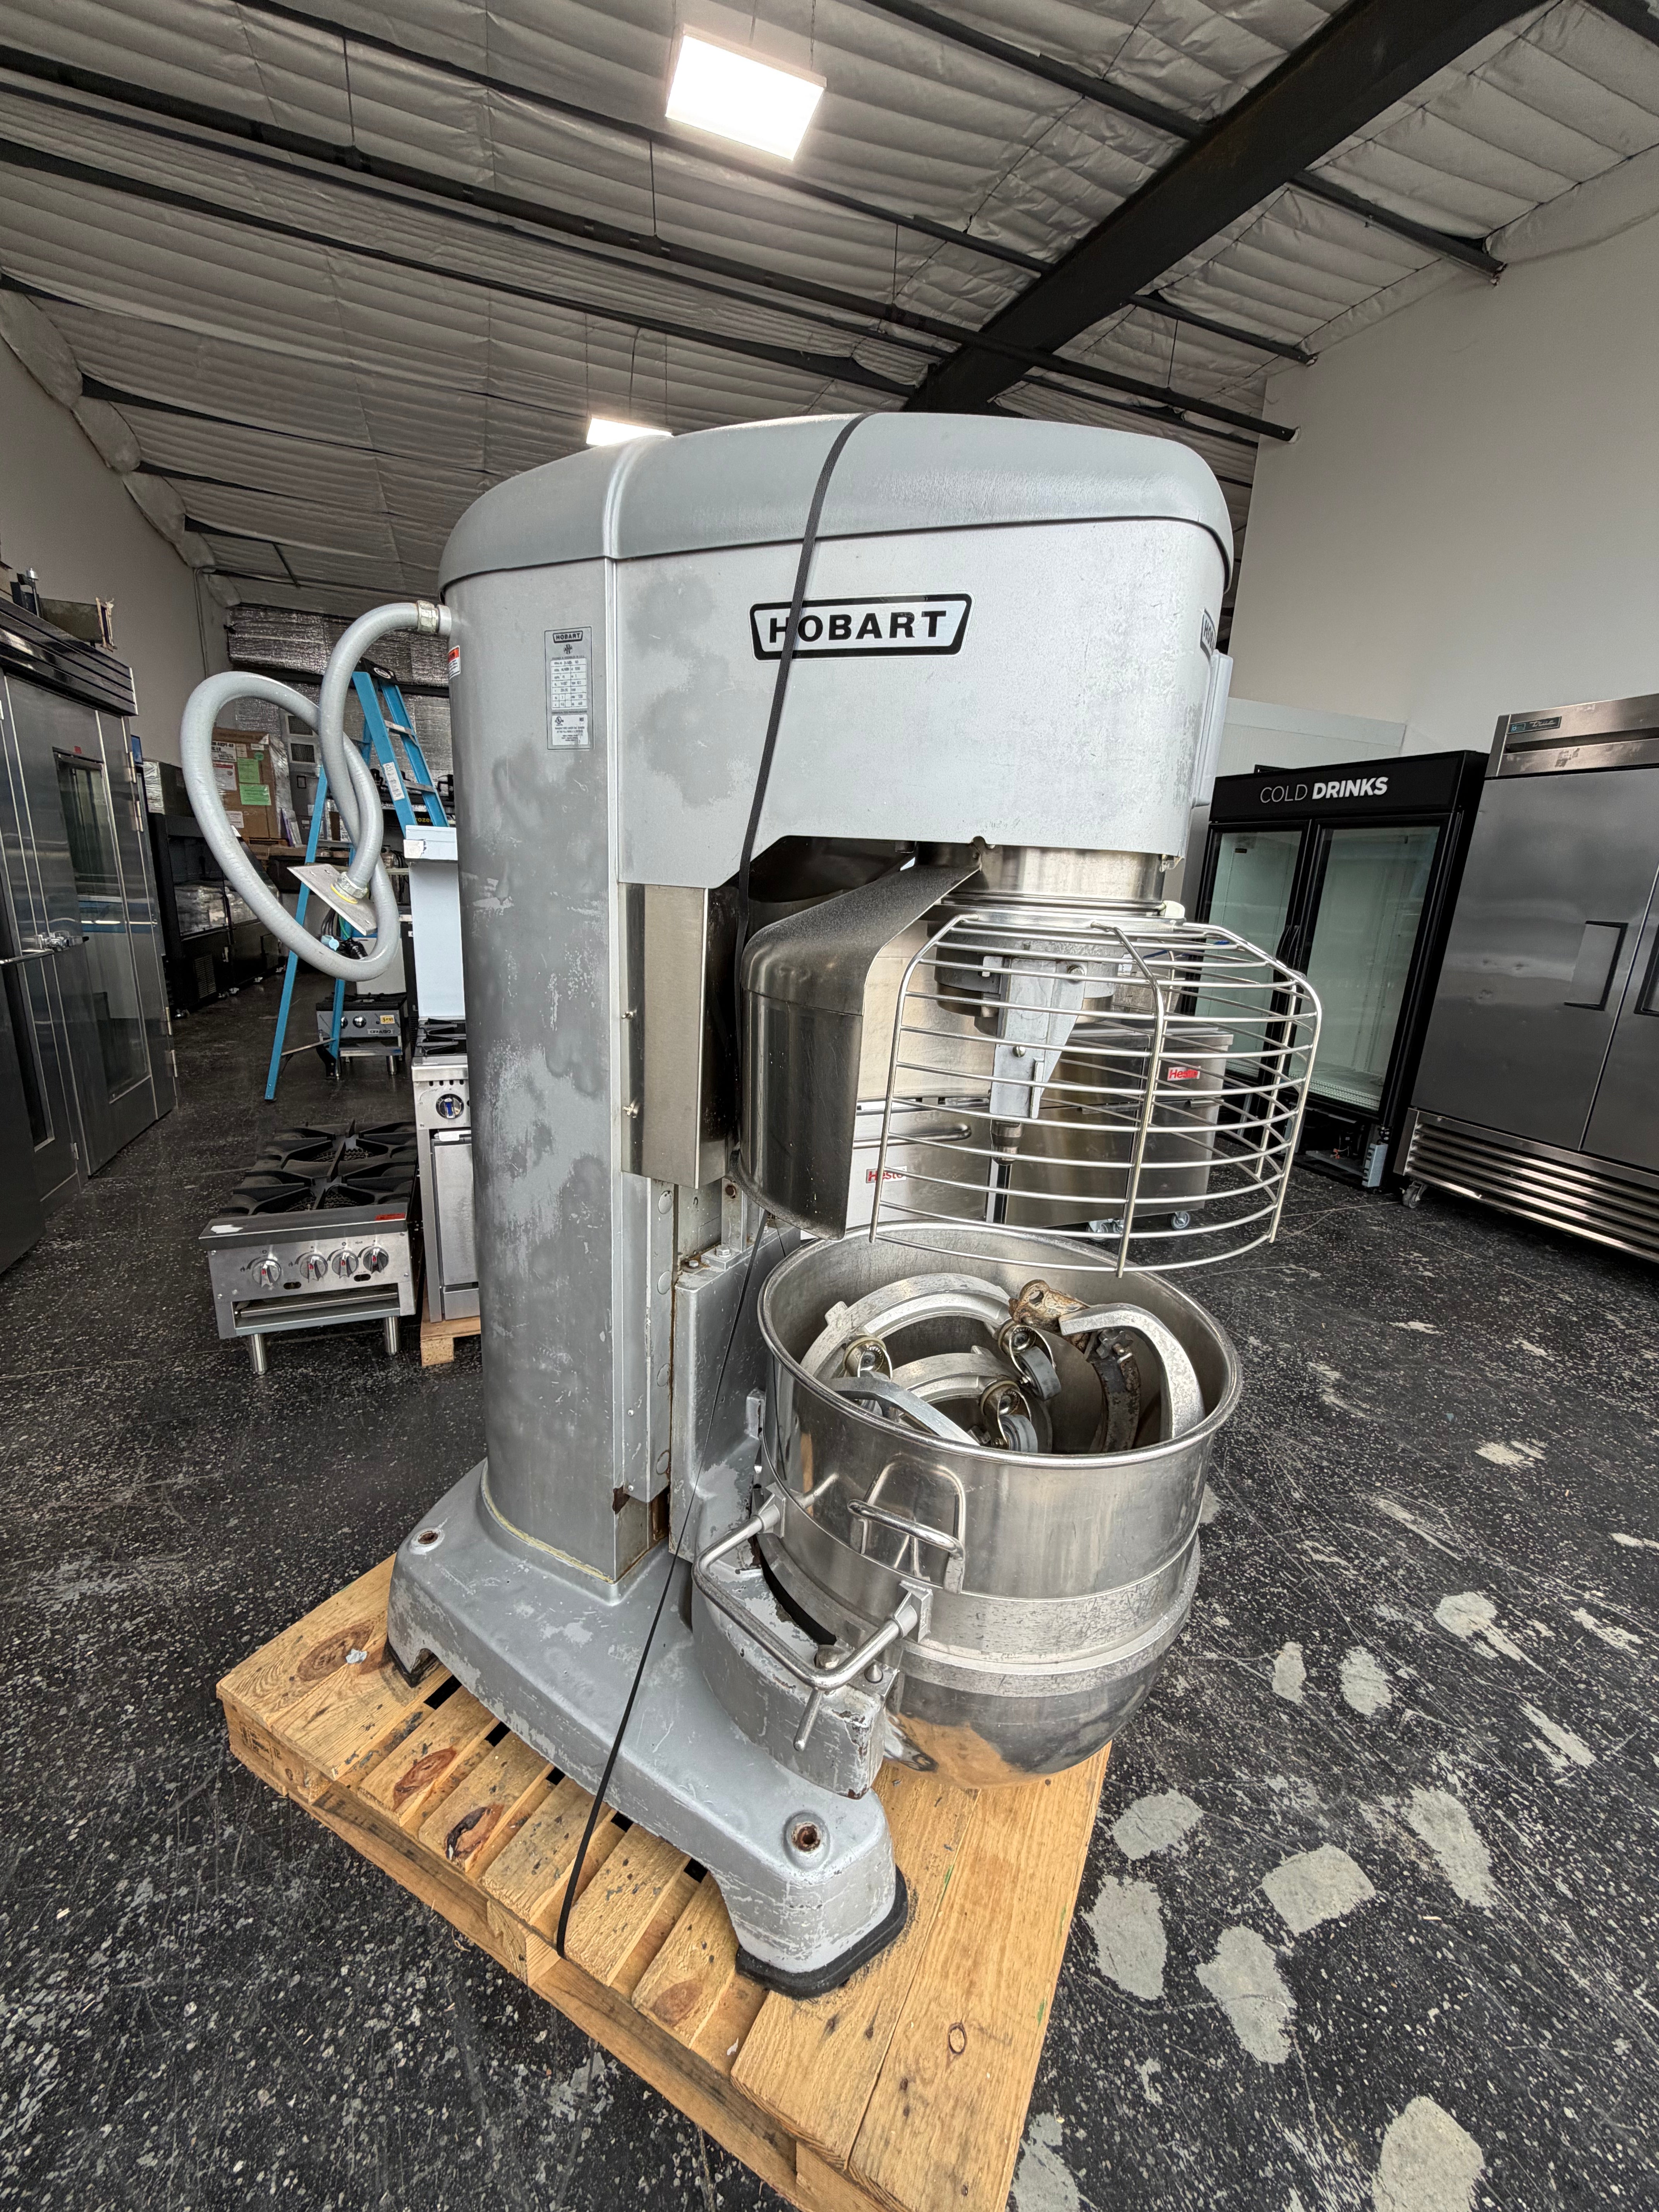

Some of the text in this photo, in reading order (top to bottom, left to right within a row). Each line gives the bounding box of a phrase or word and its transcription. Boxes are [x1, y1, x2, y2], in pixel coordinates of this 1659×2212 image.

[769, 610, 946, 643] HOBART
[1260, 776, 1389, 803] COLD DRINKS
